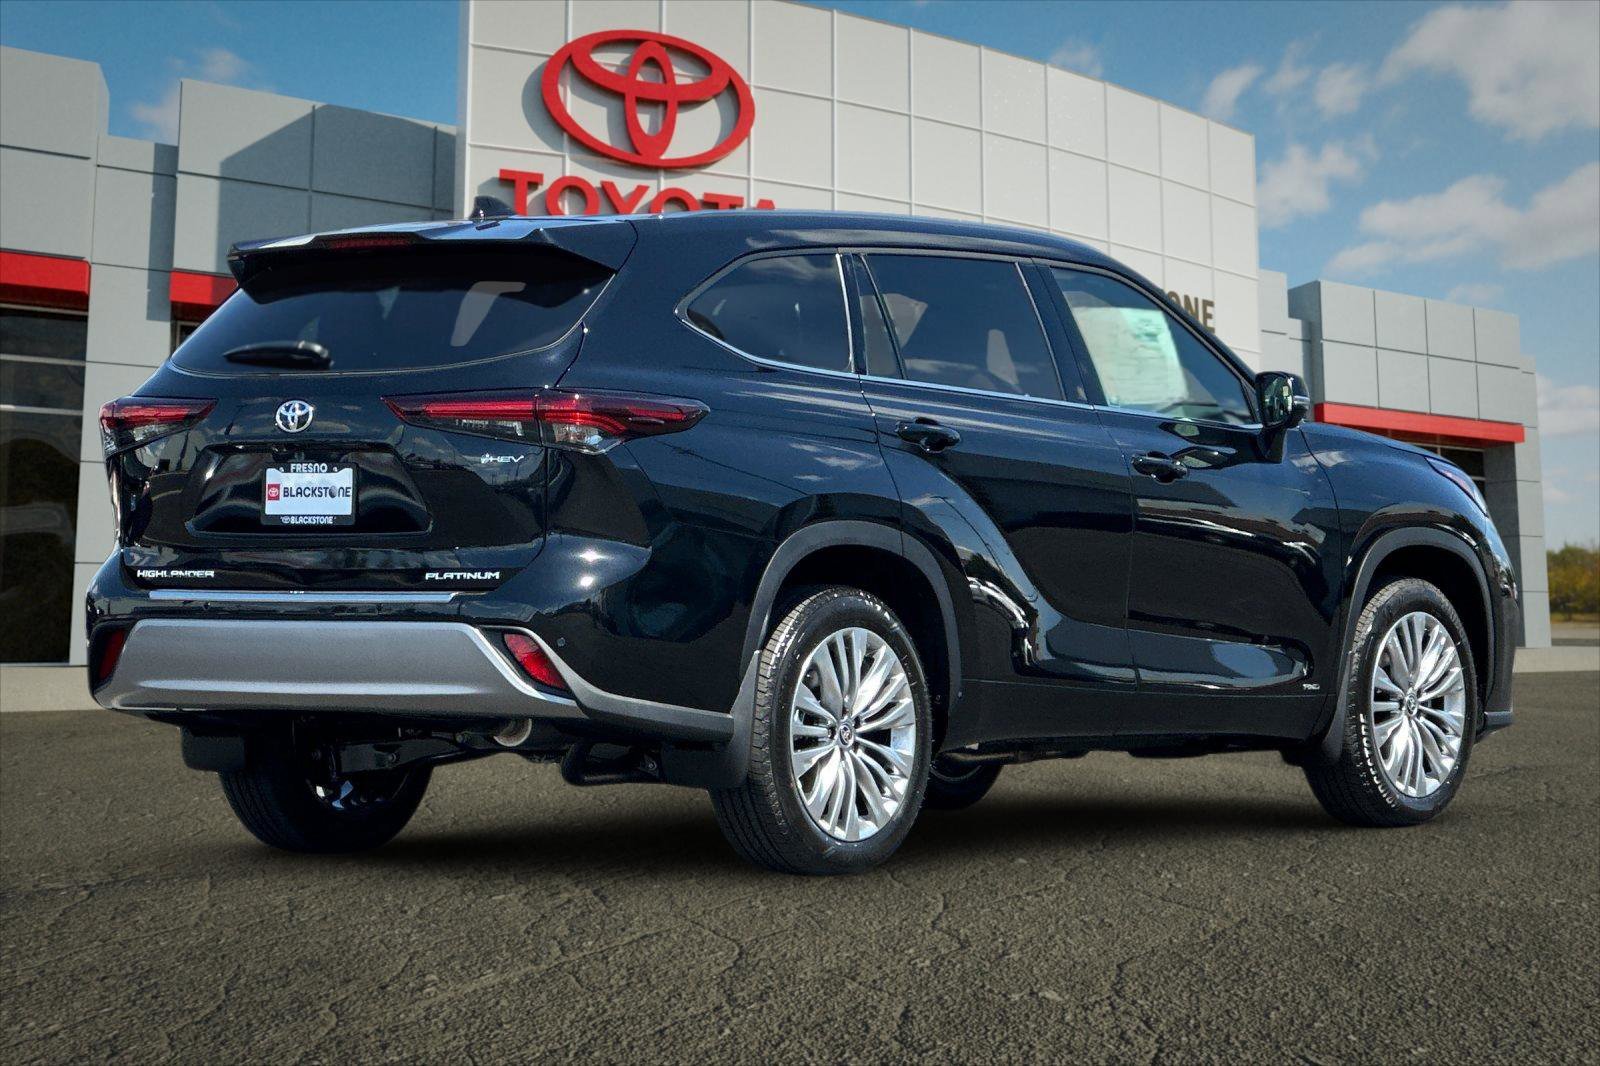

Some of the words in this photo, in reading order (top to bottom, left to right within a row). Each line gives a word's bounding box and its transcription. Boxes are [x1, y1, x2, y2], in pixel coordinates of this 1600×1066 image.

[499, 169, 777, 216] TOYO
[290, 463, 328, 473] FRESNO
[283, 486, 352, 498] BLACKSTONE
[290, 516, 334, 524] BLACKSTONE
[136, 569, 215, 578] HIGHLANDER
[425, 571, 500, 581] PLATINUM
